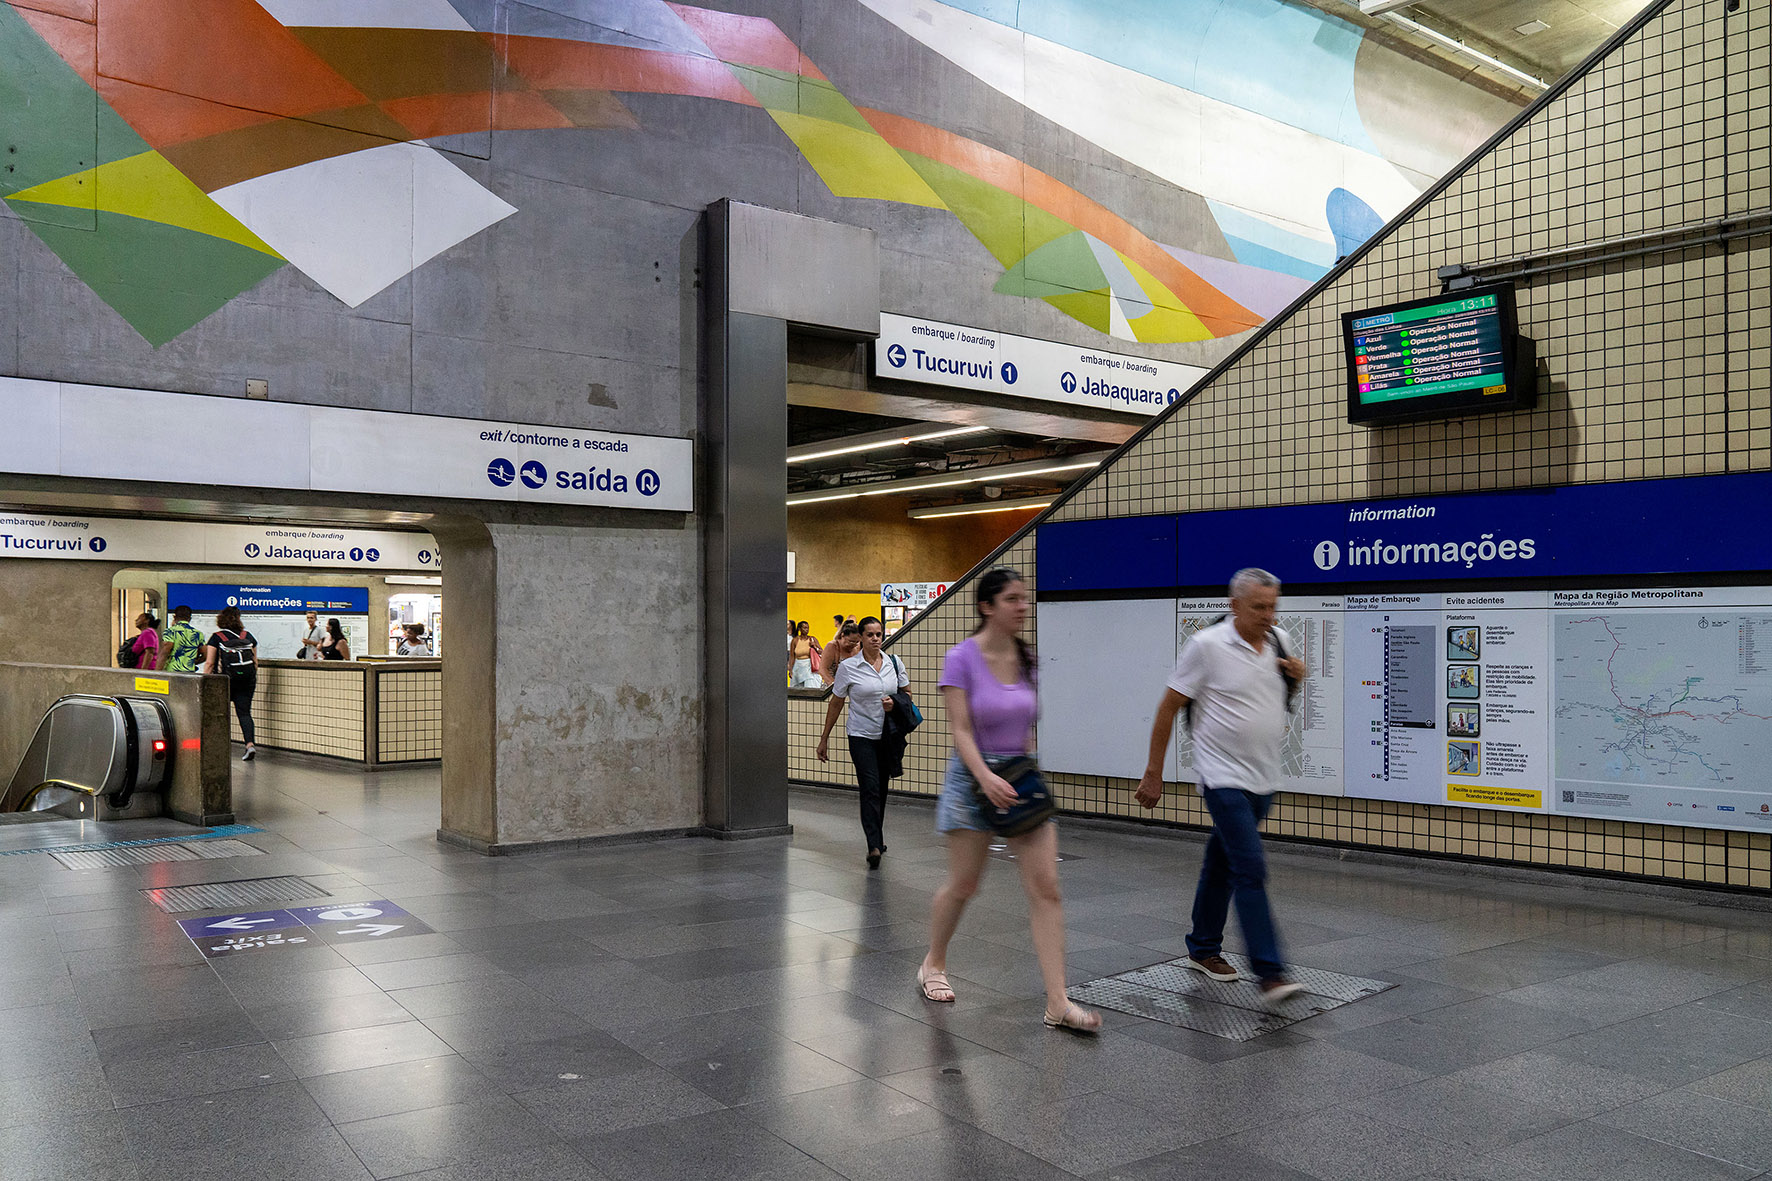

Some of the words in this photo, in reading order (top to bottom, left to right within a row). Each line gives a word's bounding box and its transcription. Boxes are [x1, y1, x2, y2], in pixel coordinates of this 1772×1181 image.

[1460, 297, 1493, 310] 13:11
[1365, 335, 1382, 343] Azul
[1409, 324, 1446, 336] Operação
[1447, 319, 1477, 330] Normal
[1366, 316, 1390, 325] METRÔ
[911, 324, 955, 341] embarque
[961, 332, 996, 349] boarding
[1366, 344, 1387, 353] Verde
[1410, 333, 1447, 346] Operação
[1449, 329, 1478, 339] Normal
[1366, 351, 1401, 362] Vermelha
[1411, 343, 1448, 355] Operação
[1450, 338, 1479, 349] Normal
[1368, 363, 1387, 371] Prata
[1412, 353, 1449, 365] Operação
[1450, 348, 1480, 358] Normal
[912, 349, 992, 380] Tucuruvi
[1080, 354, 1121, 369] embarque
[1126, 361, 1157, 376] boarding
[1369, 371, 1399, 381] Amarela
[1413, 362, 1450, 375] Operação
[1452, 358, 1481, 369] Normal
[1370, 382, 1388, 390] Lilás
[1414, 372, 1451, 384] Operação
[1453, 368, 1482, 378] Normal
[1081, 376, 1163, 405] Jabaquara
[572, 439, 580, 449] a
[584, 440, 629, 452] escada
[556, 466, 628, 492] saída
[1349, 503, 1436, 522] information
[0, 518, 46, 527] embarque
[52, 520, 89, 530] boarding
[0, 534, 82, 551] Tucuruvi
[265, 530, 307, 539] embarque
[311, 532, 344, 541] boarding
[265, 545, 345, 561] Jabaquara
[1348, 533, 1536, 568] informações
[239, 596, 302, 608] informações
[1381, 596, 1420, 604] Embarque
[1554, 592, 1579, 601] Mapa
[1582, 592, 1593, 600] da
[1596, 591, 1629, 601] Região
[1631, 590, 1703, 599] Metropolitana
